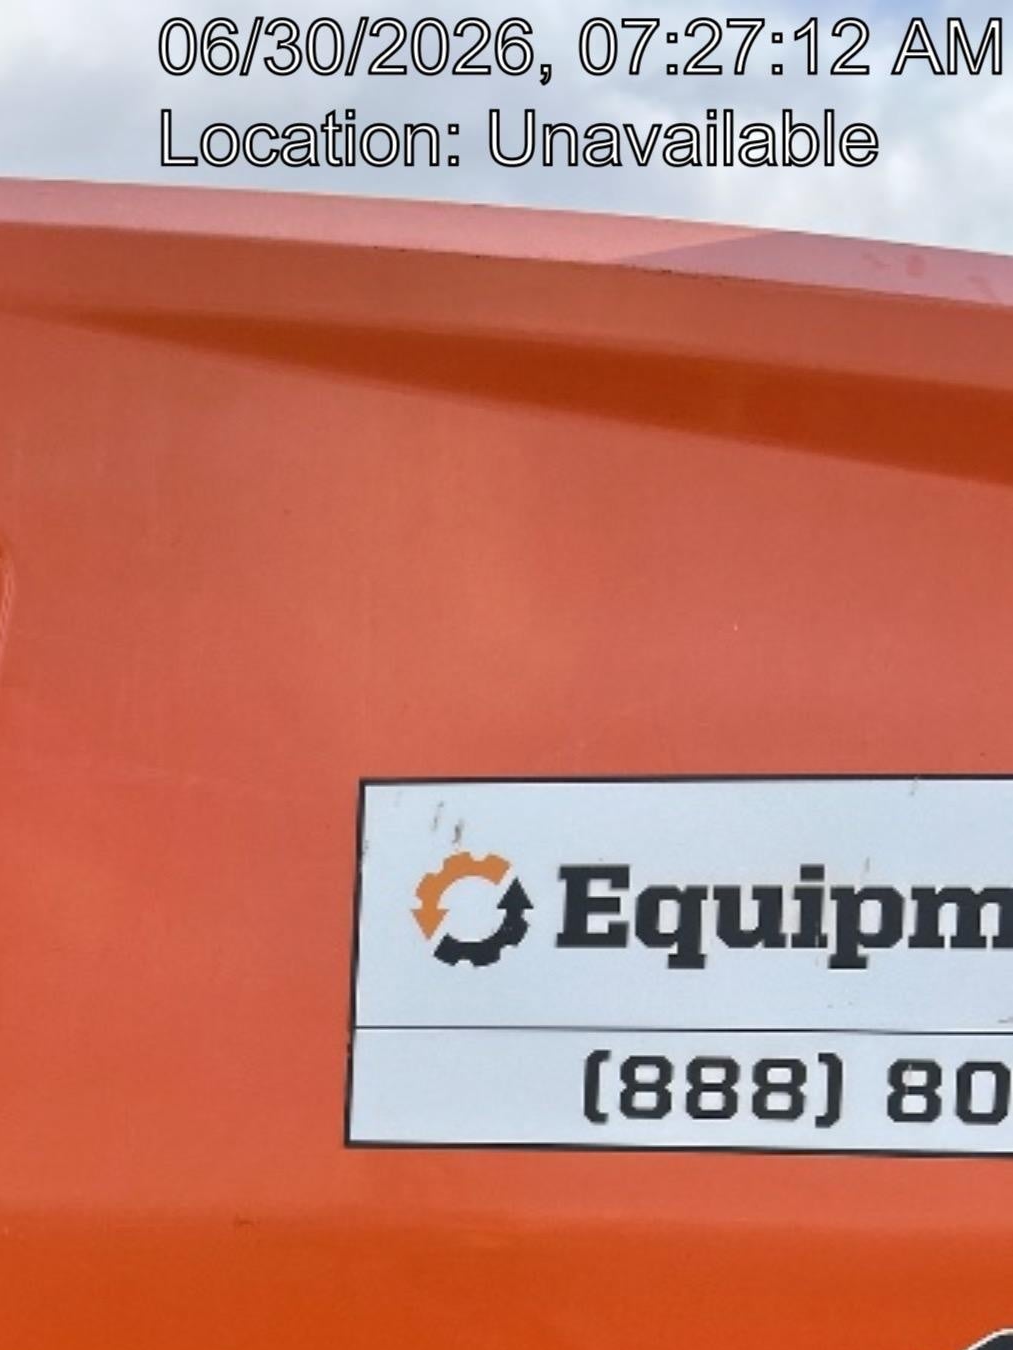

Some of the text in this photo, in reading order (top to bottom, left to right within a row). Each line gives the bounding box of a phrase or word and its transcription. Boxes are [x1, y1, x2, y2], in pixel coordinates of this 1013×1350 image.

[555, 863, 1013, 970] Equipm
[584, 1049, 1012, 1128] (888) 80
